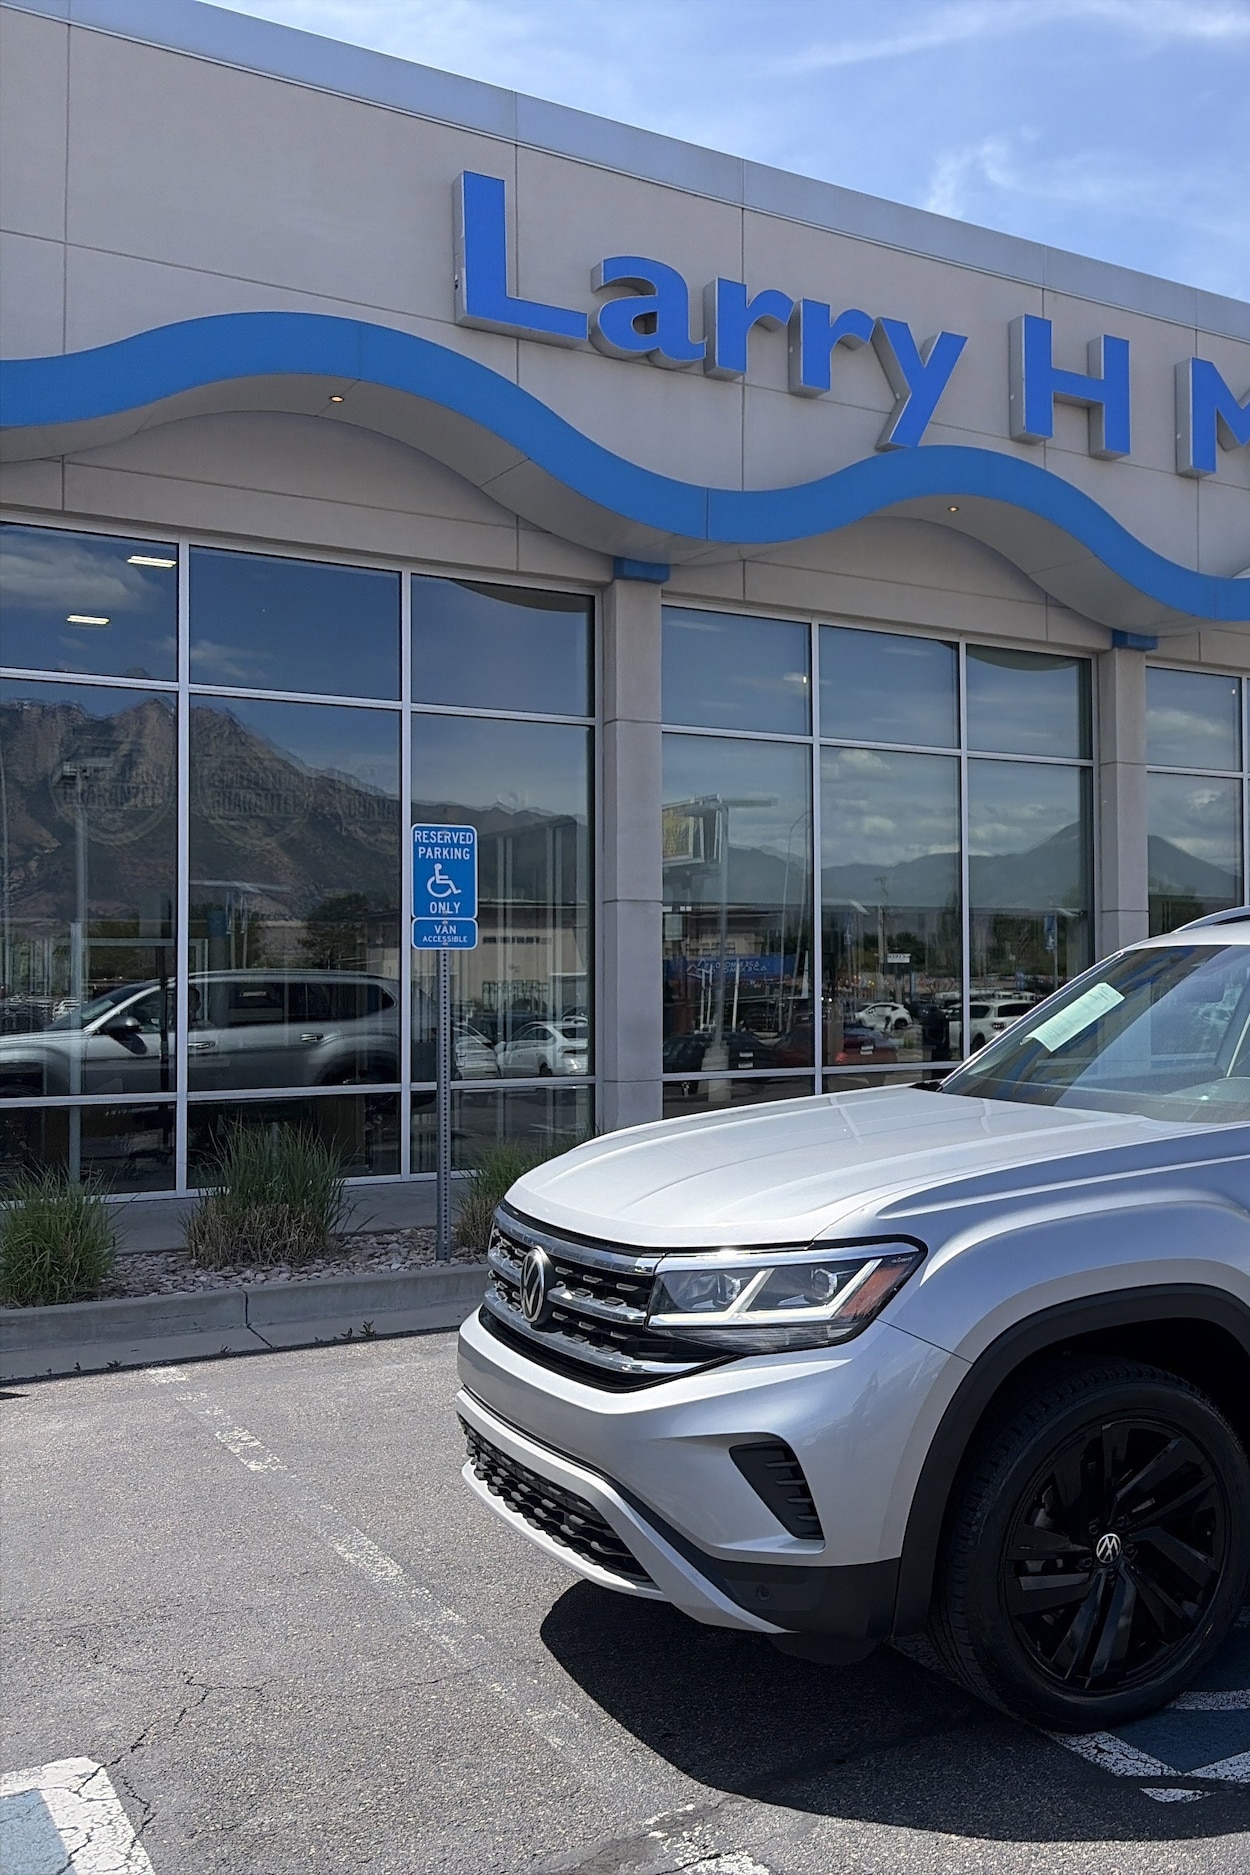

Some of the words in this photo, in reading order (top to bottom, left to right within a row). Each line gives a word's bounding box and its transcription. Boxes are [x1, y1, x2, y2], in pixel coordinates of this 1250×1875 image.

[455, 170, 968, 451] Larry
[1010, 313, 1131, 459] H
[414, 830, 474, 845] RESERVED
[418, 846, 470, 860] PARKING
[429, 901, 461, 914] ONLY
[434, 925, 457, 935] VAN
[422, 935, 468, 943] ACCESSIBLE
